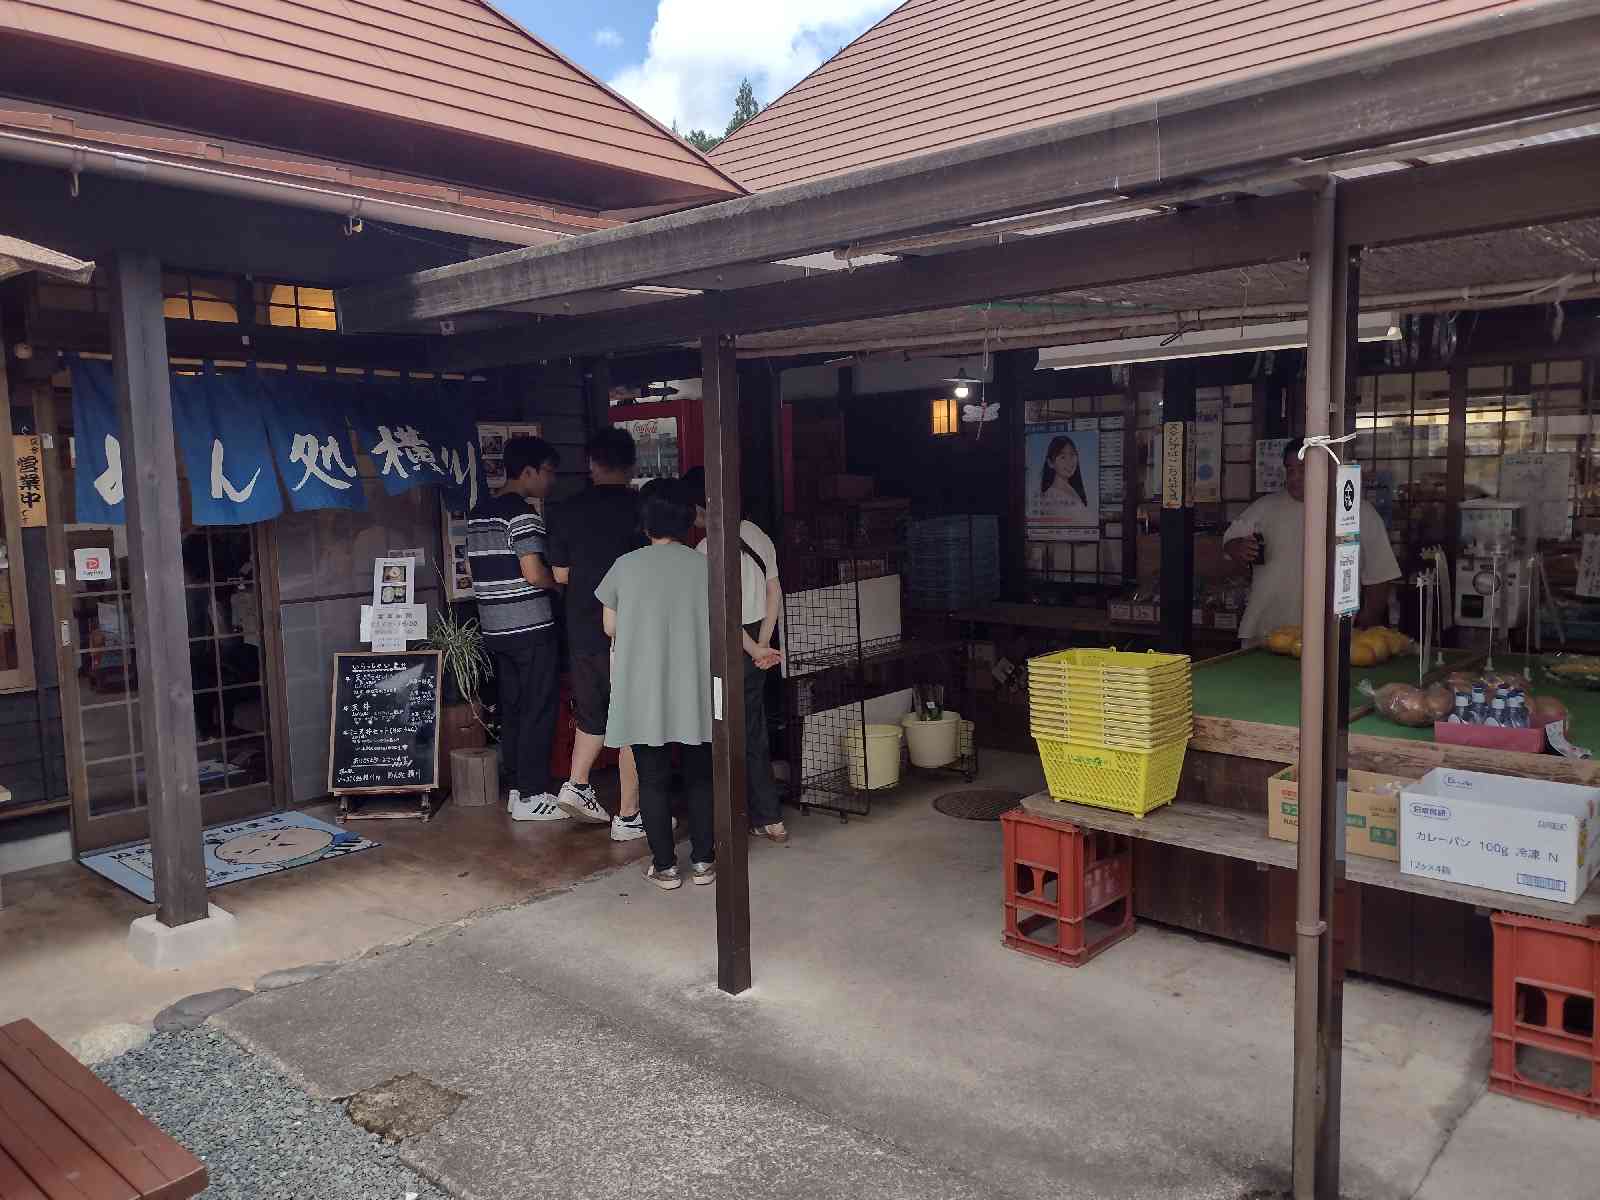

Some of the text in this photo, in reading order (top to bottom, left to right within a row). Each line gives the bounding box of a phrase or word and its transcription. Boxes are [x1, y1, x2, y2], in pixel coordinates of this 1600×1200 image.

[1416, 830, 1472, 848] カレーパン
[1479, 840, 1509, 857] 100g
[1548, 851, 1560, 864] N
